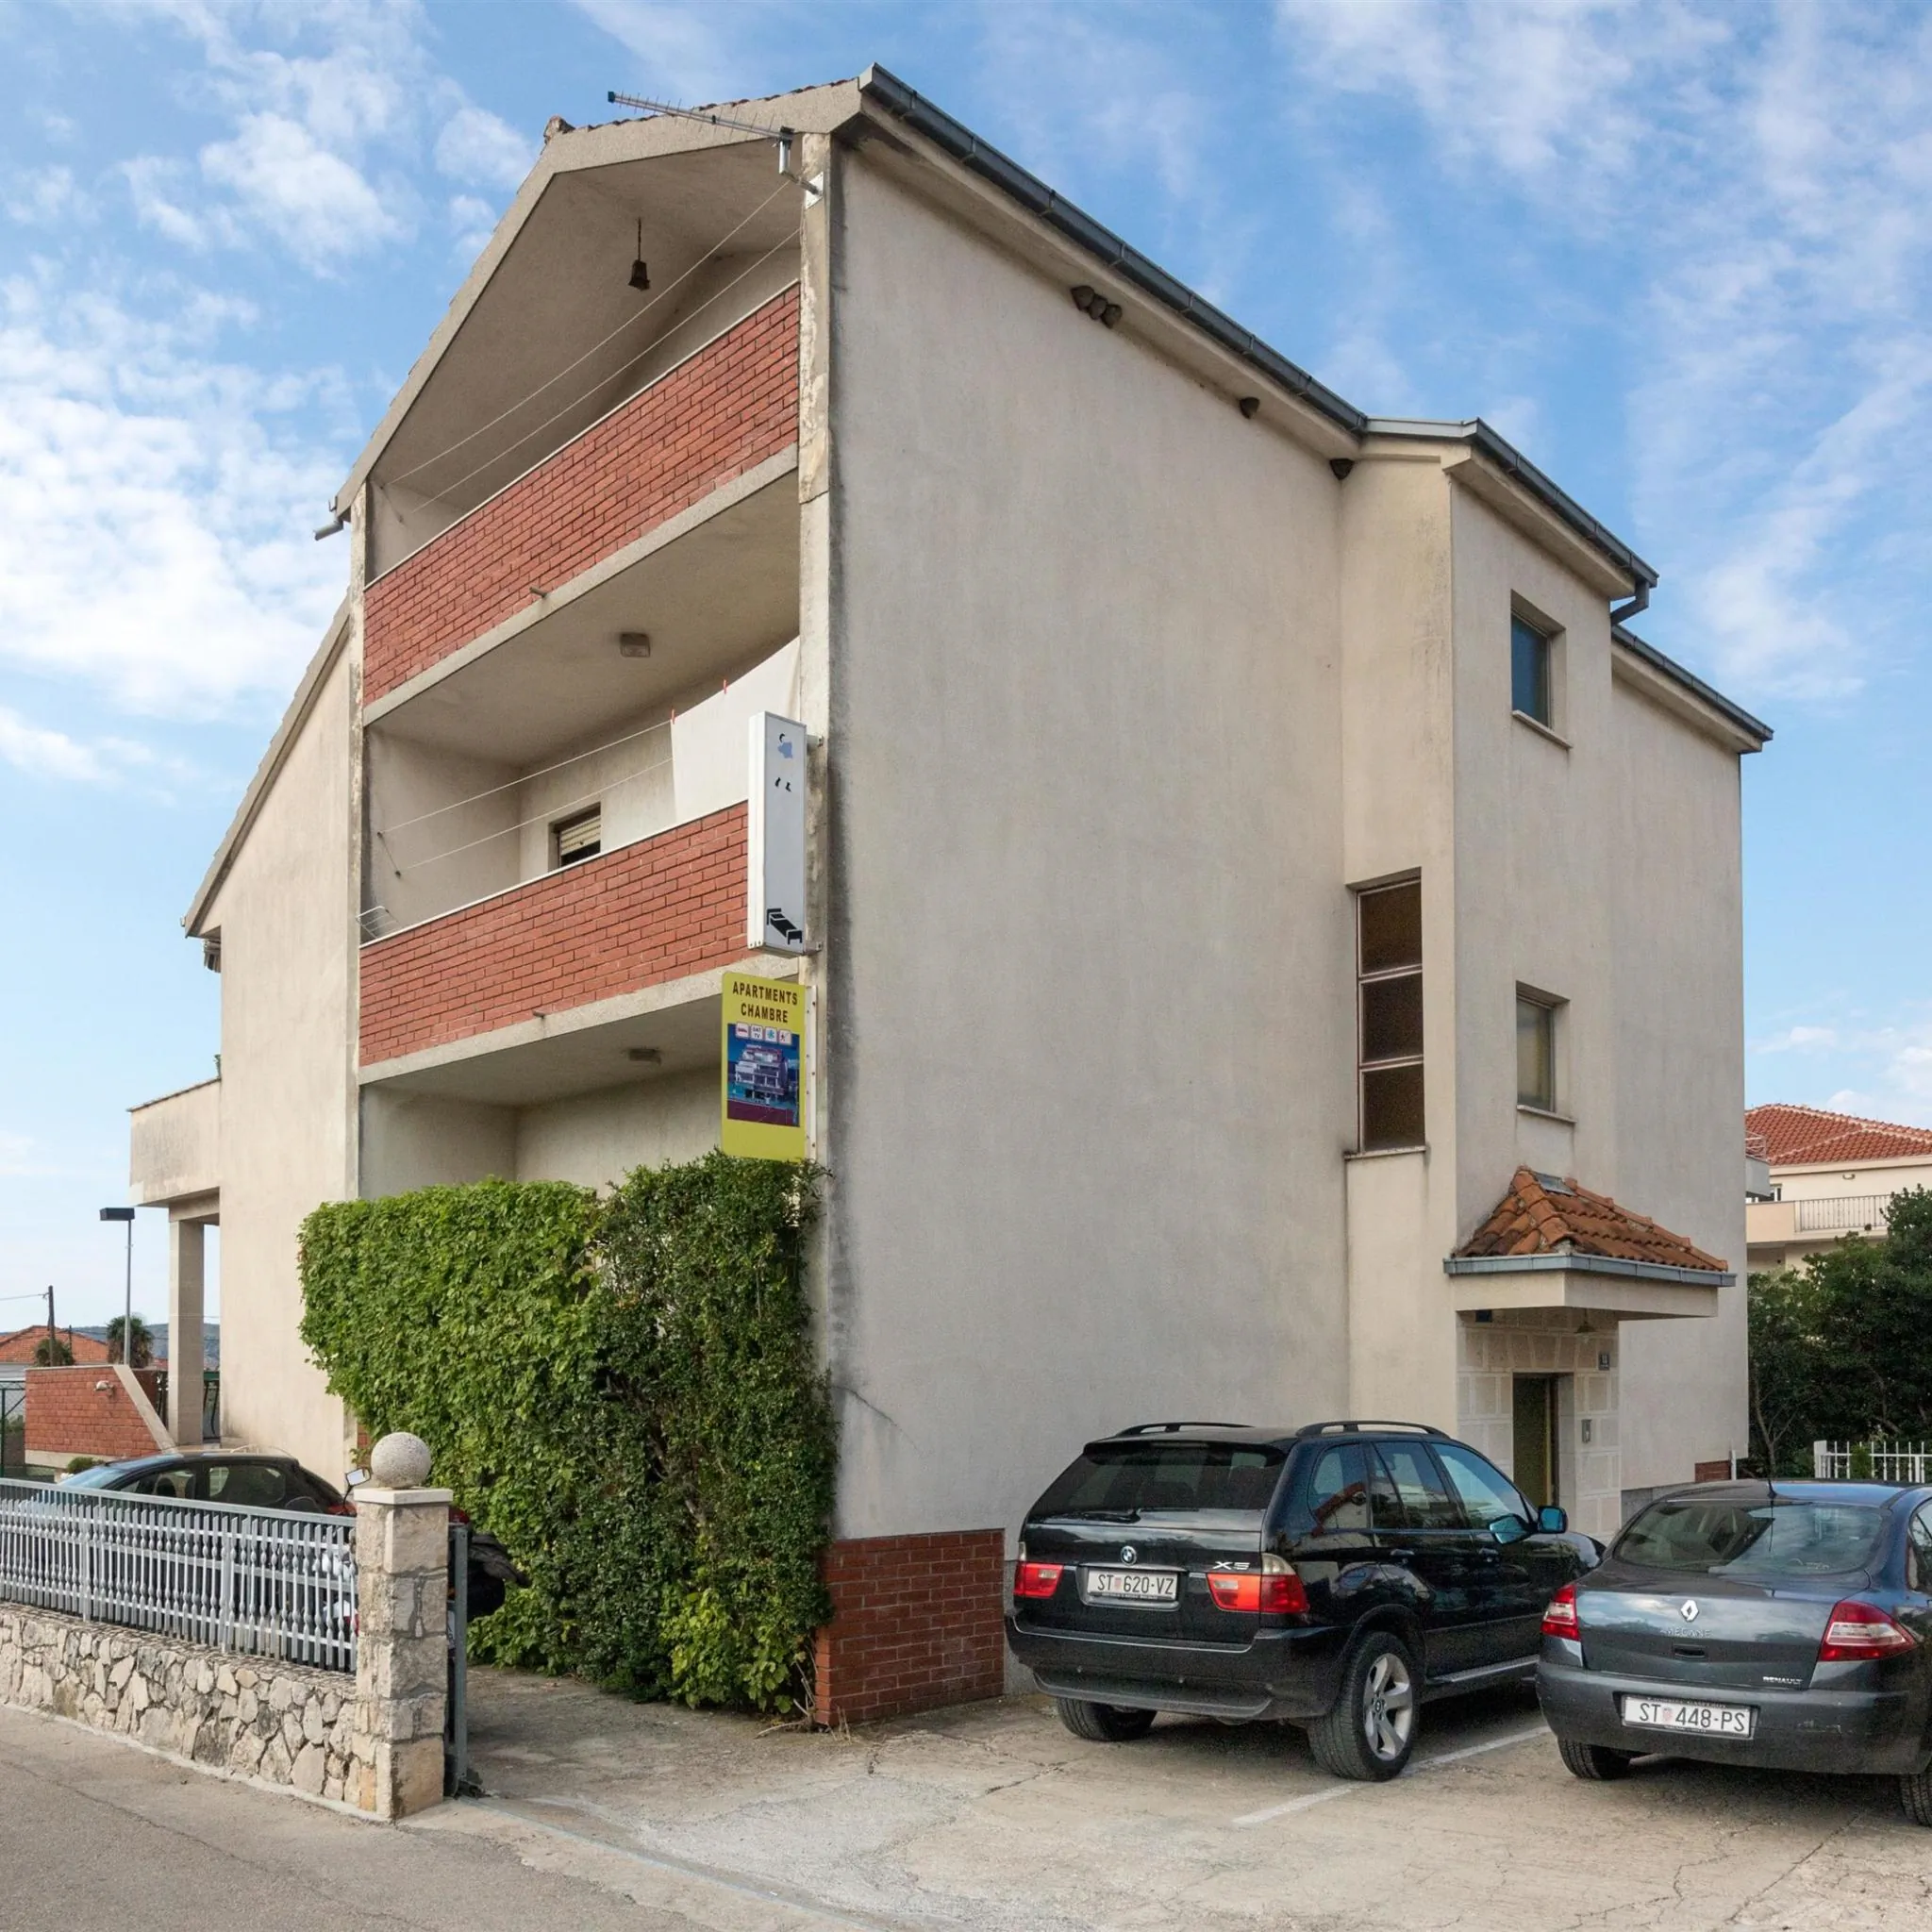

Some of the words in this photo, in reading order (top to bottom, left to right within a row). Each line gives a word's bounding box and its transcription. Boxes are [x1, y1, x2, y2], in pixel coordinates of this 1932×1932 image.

[733, 981, 797, 1005] APARTMENTS
[741, 1003, 788, 1023] CHAMBRE
[1212, 1561, 1250, 1571] X5
[1097, 1574, 1114, 1591] ST
[1762, 1675, 1804, 1685] RENAULT
[1640, 1702, 1660, 1722] ST
[1675, 1707, 1745, 1732] 448-PS
